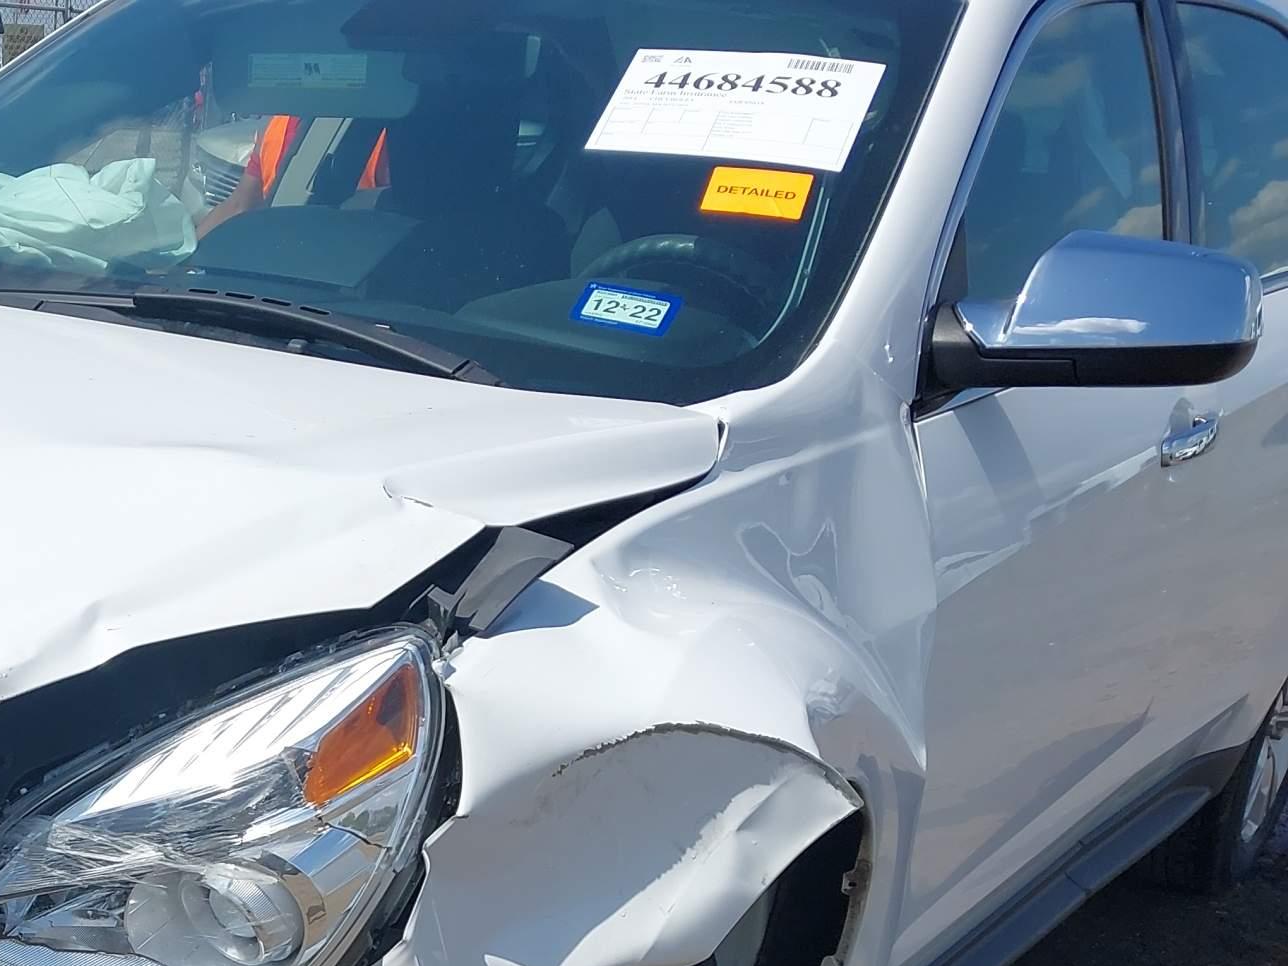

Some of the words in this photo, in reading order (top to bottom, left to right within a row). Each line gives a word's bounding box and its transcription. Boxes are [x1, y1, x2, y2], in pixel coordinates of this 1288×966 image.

[644, 71, 843, 98] 44684588
[716, 185, 797, 200] DETAILED
[592, 298, 621, 314] 12
[628, 304, 662, 322] 22
